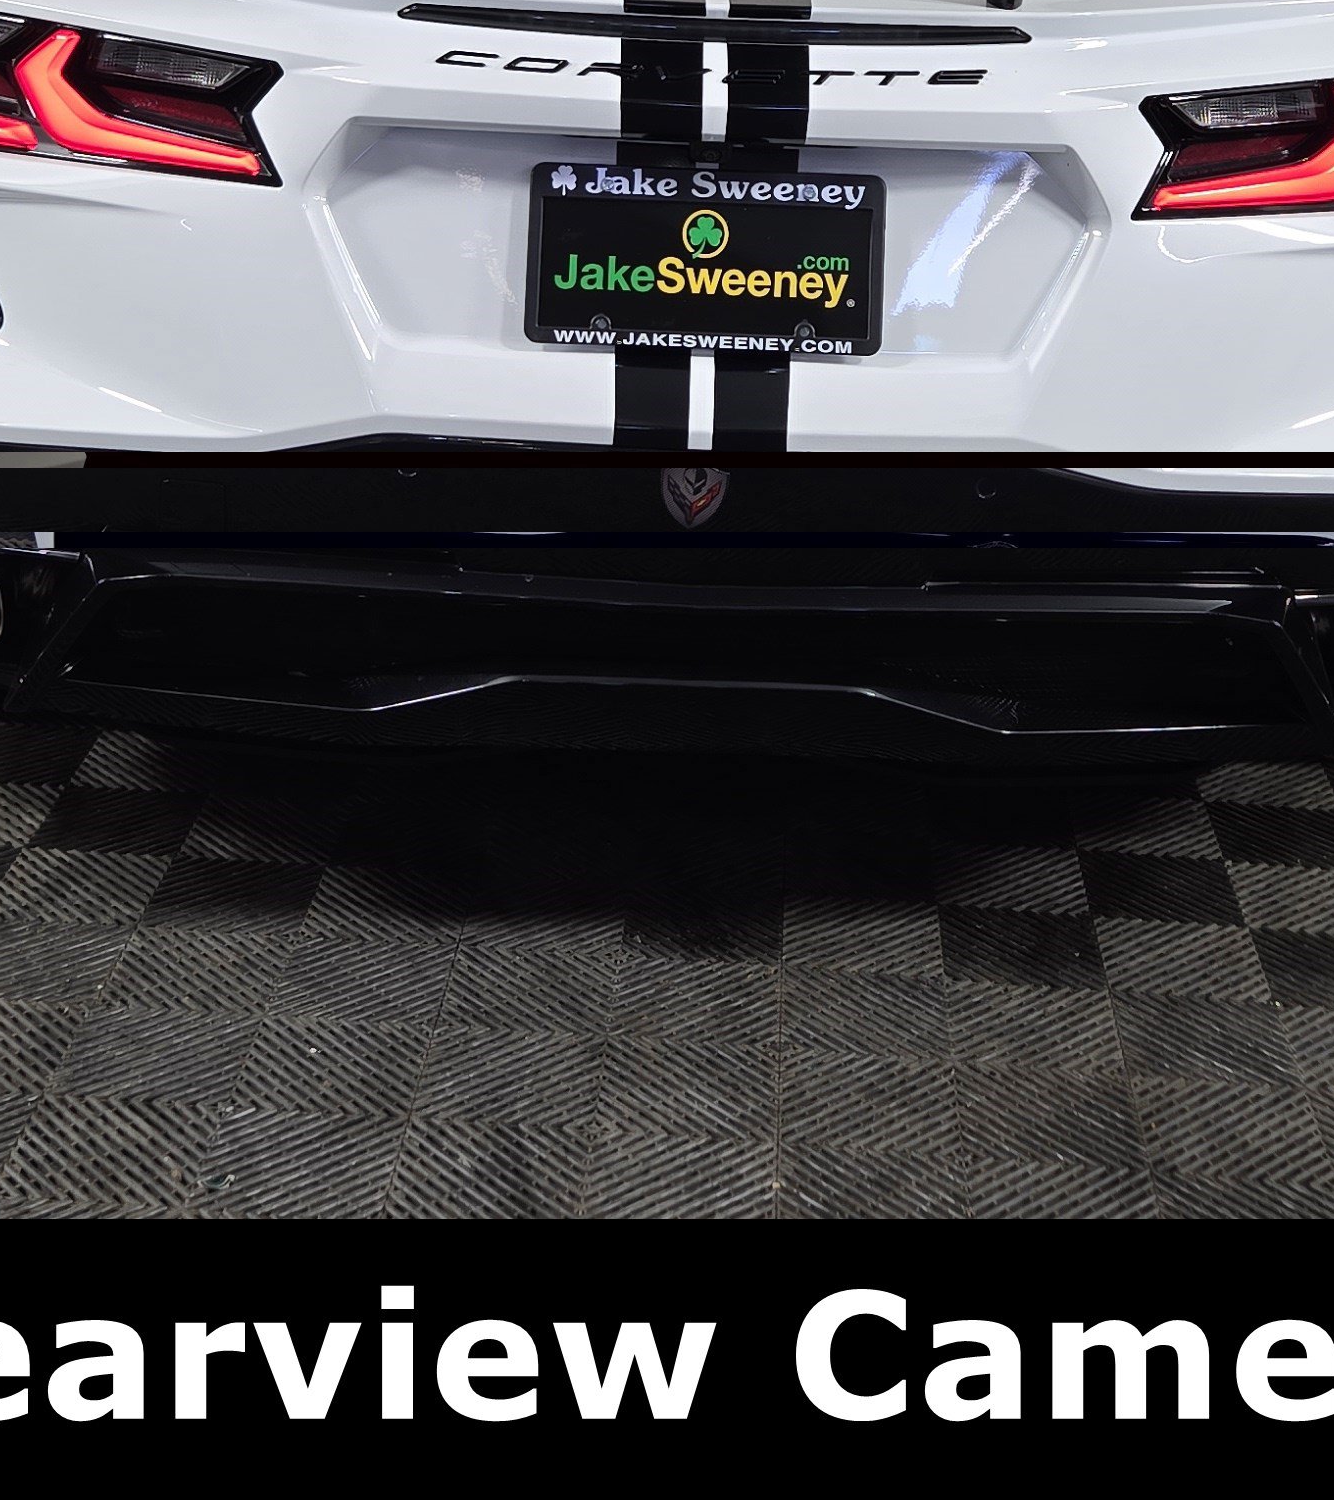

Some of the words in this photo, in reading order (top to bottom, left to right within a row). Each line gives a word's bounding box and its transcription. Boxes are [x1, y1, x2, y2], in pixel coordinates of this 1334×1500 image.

[435, 50, 989, 87] CORVETTE
[585, 167, 678, 198] Jake
[691, 171, 866, 210] Sweeney
[796, 255, 850, 272] .com
[553, 329, 853, 355] WWW.JAKESWEENEY.COM
